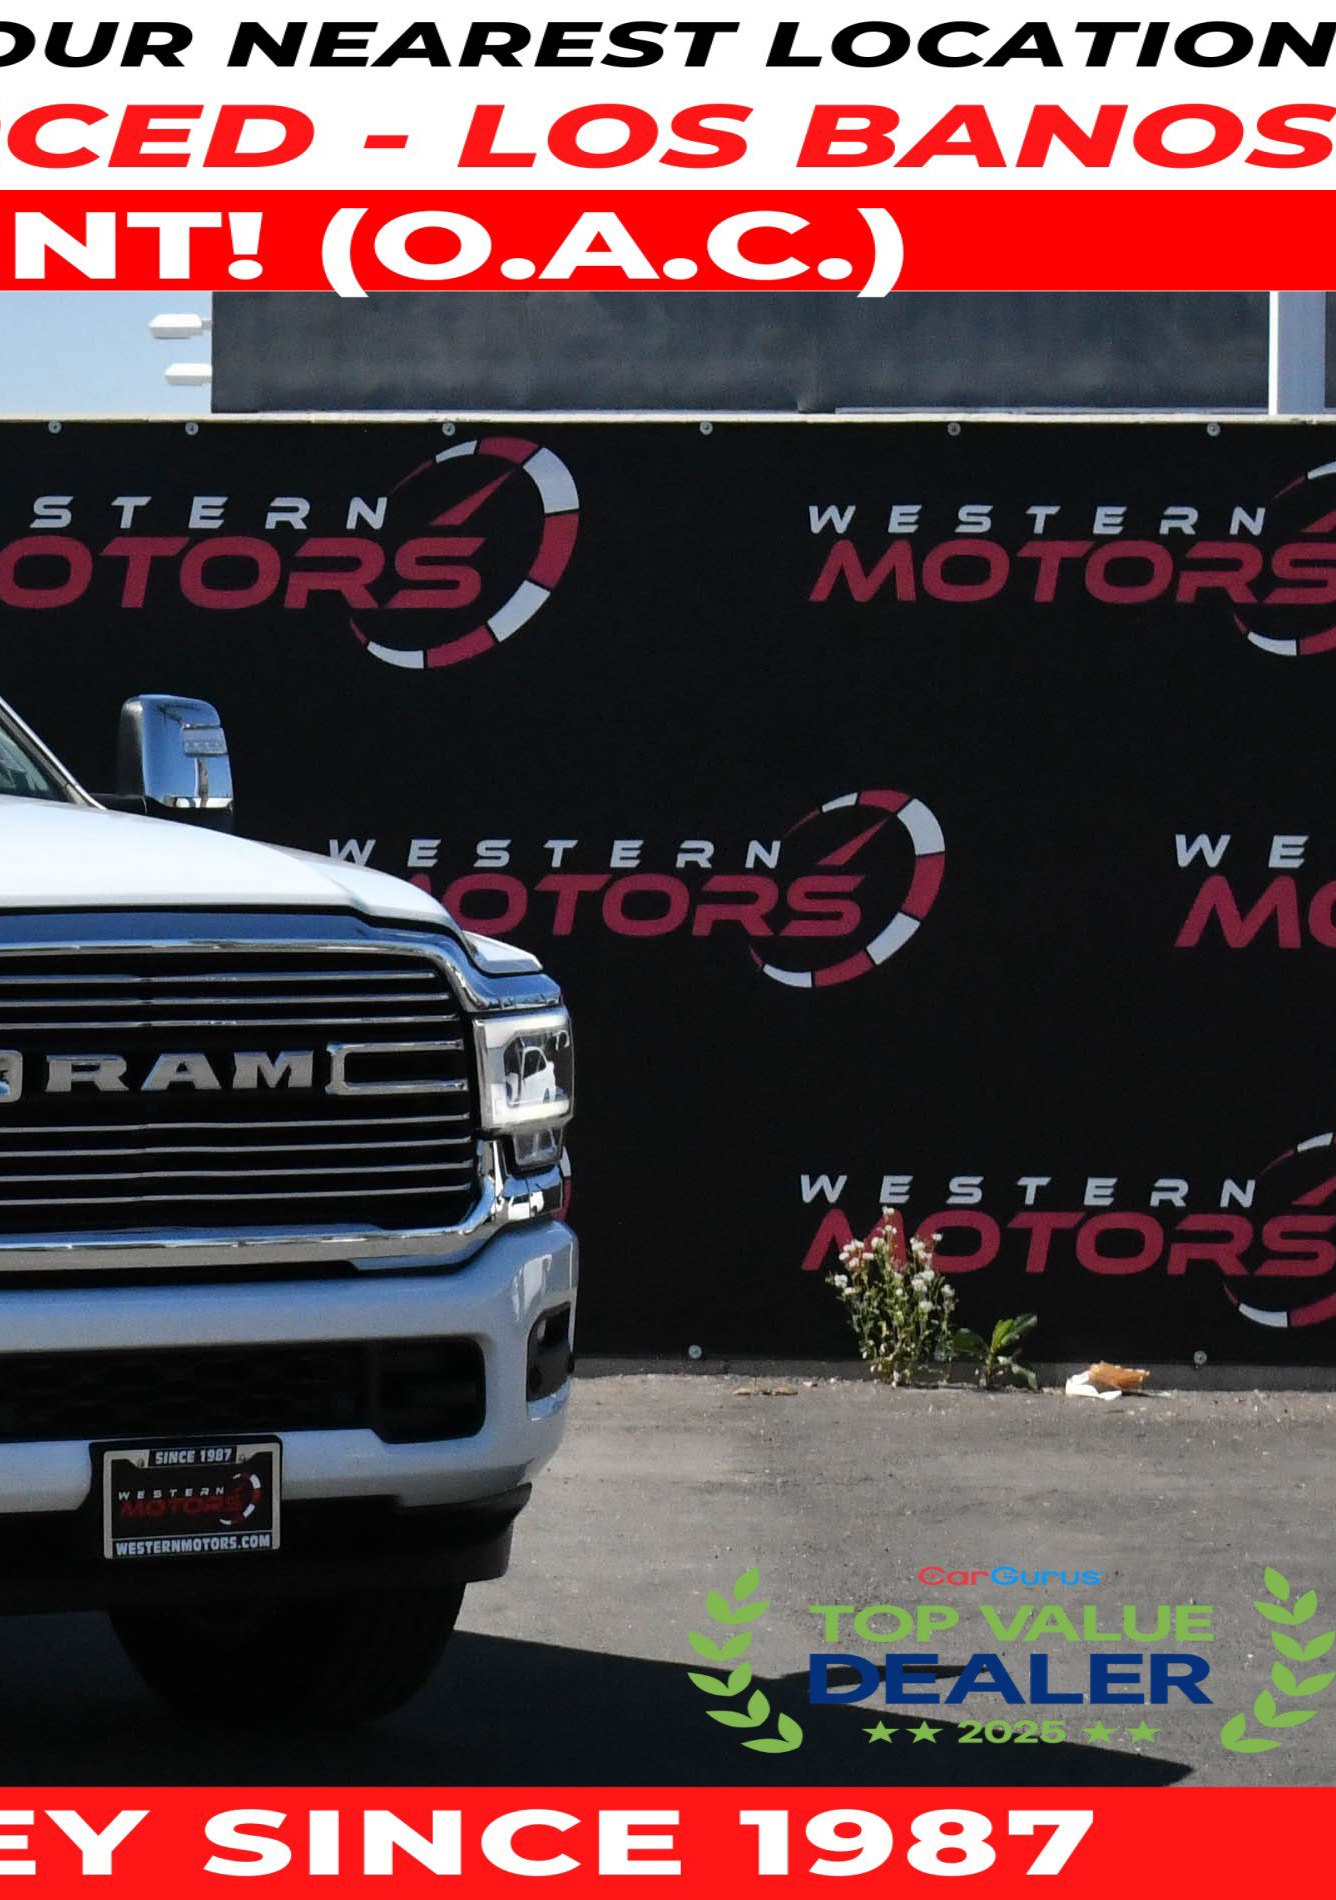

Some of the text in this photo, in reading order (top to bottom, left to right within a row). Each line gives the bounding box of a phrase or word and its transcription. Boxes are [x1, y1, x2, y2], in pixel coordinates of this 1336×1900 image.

[809, 505, 1267, 535] WESTERN
[809, 538, 1336, 605] MOTORS
[329, 838, 781, 868] WESTERN
[410, 873, 866, 937] OTORS
[44, 1049, 314, 1093] RAM
[800, 1174, 1257, 1209] WESTERN
[800, 1208, 1336, 1276] MOTORS
[154, 1447, 233, 1465] SINCE 1987
[118, 1486, 225, 1501] WESTERN
[115, 1534, 271, 1556] WESTERNMOTORS.COM
